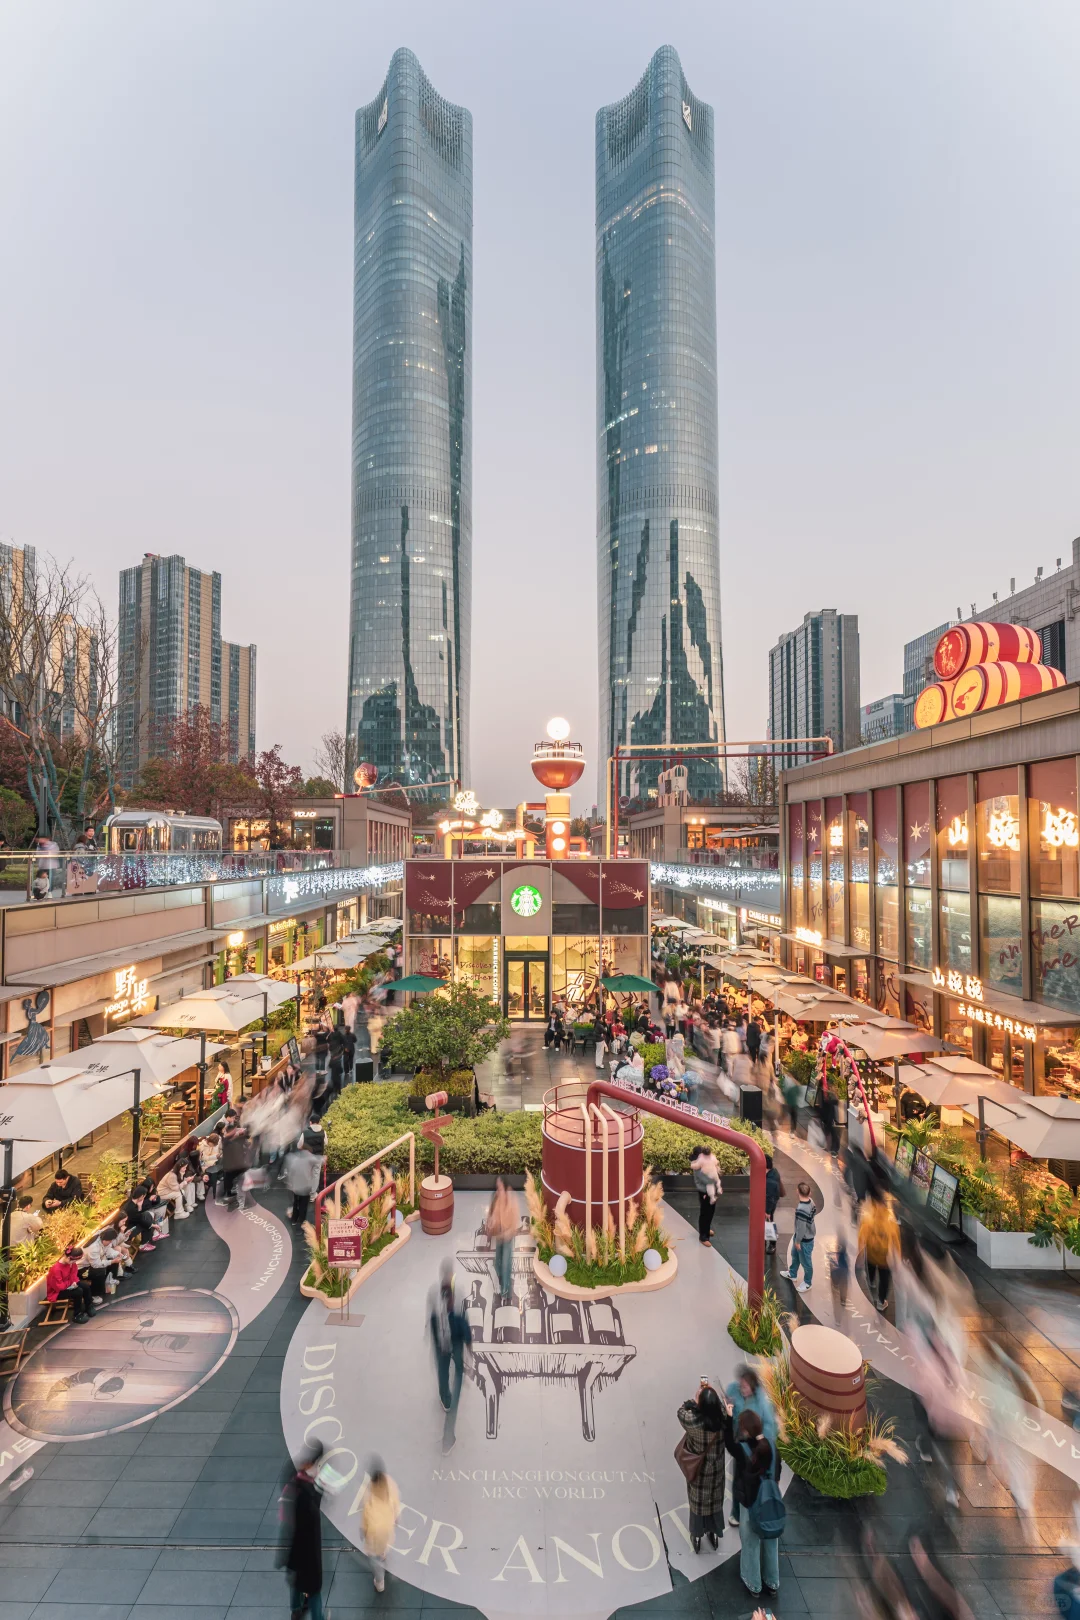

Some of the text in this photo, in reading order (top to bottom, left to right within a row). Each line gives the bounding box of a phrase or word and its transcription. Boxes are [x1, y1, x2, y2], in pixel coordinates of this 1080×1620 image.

[114, 965, 150, 1011] 野果
[640, 1087, 658, 1100] MY
[659, 1094, 699, 1115] OTHER
[701, 1110, 731, 1129] SIDE
[431, 1469, 656, 1483] NANCHANGHONGGUTAN
[481, 1486, 605, 1499] MIXC WORLD
